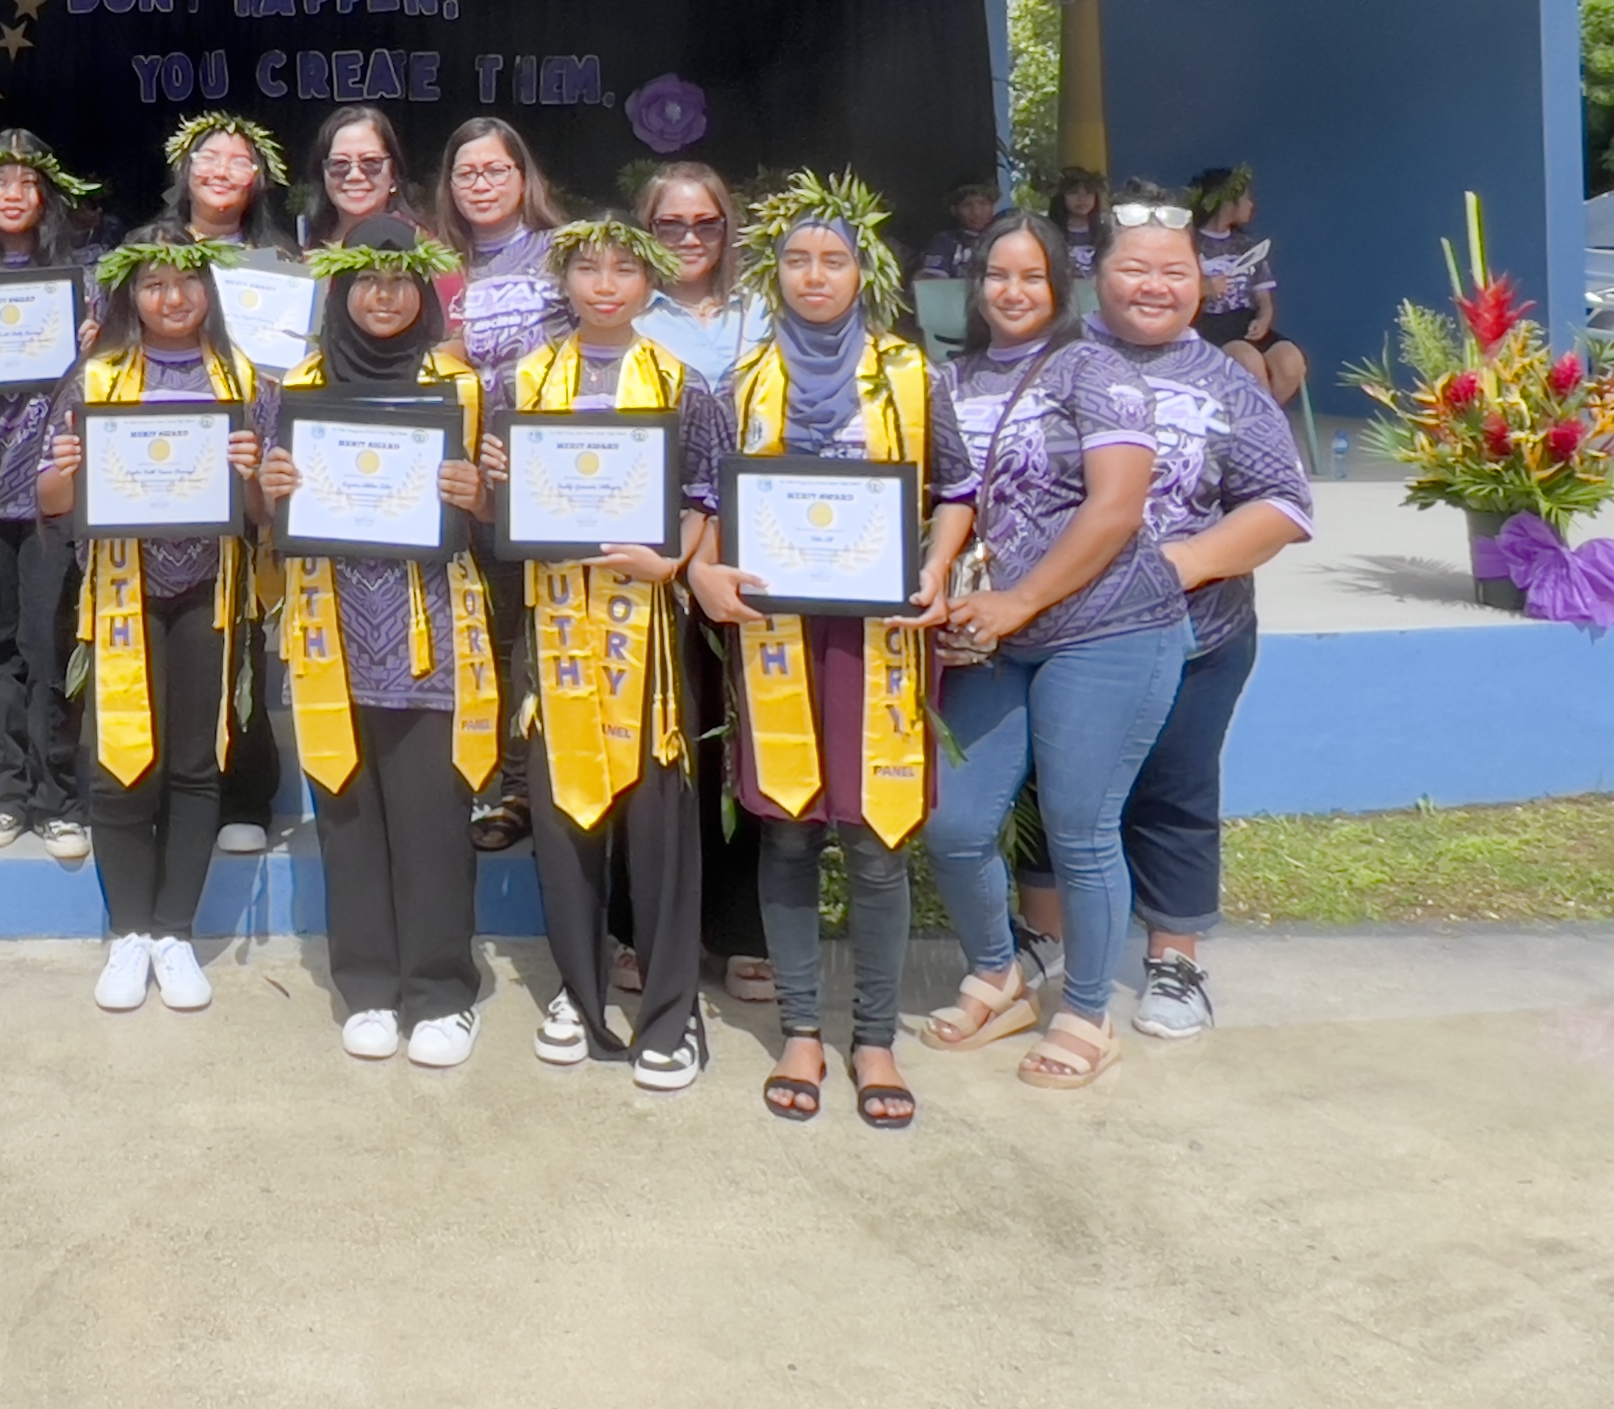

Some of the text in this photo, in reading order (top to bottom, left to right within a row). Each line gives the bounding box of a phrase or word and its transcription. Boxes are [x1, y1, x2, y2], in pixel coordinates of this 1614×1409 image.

[131, 49, 229, 103] YOU
[255, 48, 441, 102] CREATE
[873, 765, 916, 778] PANEL
